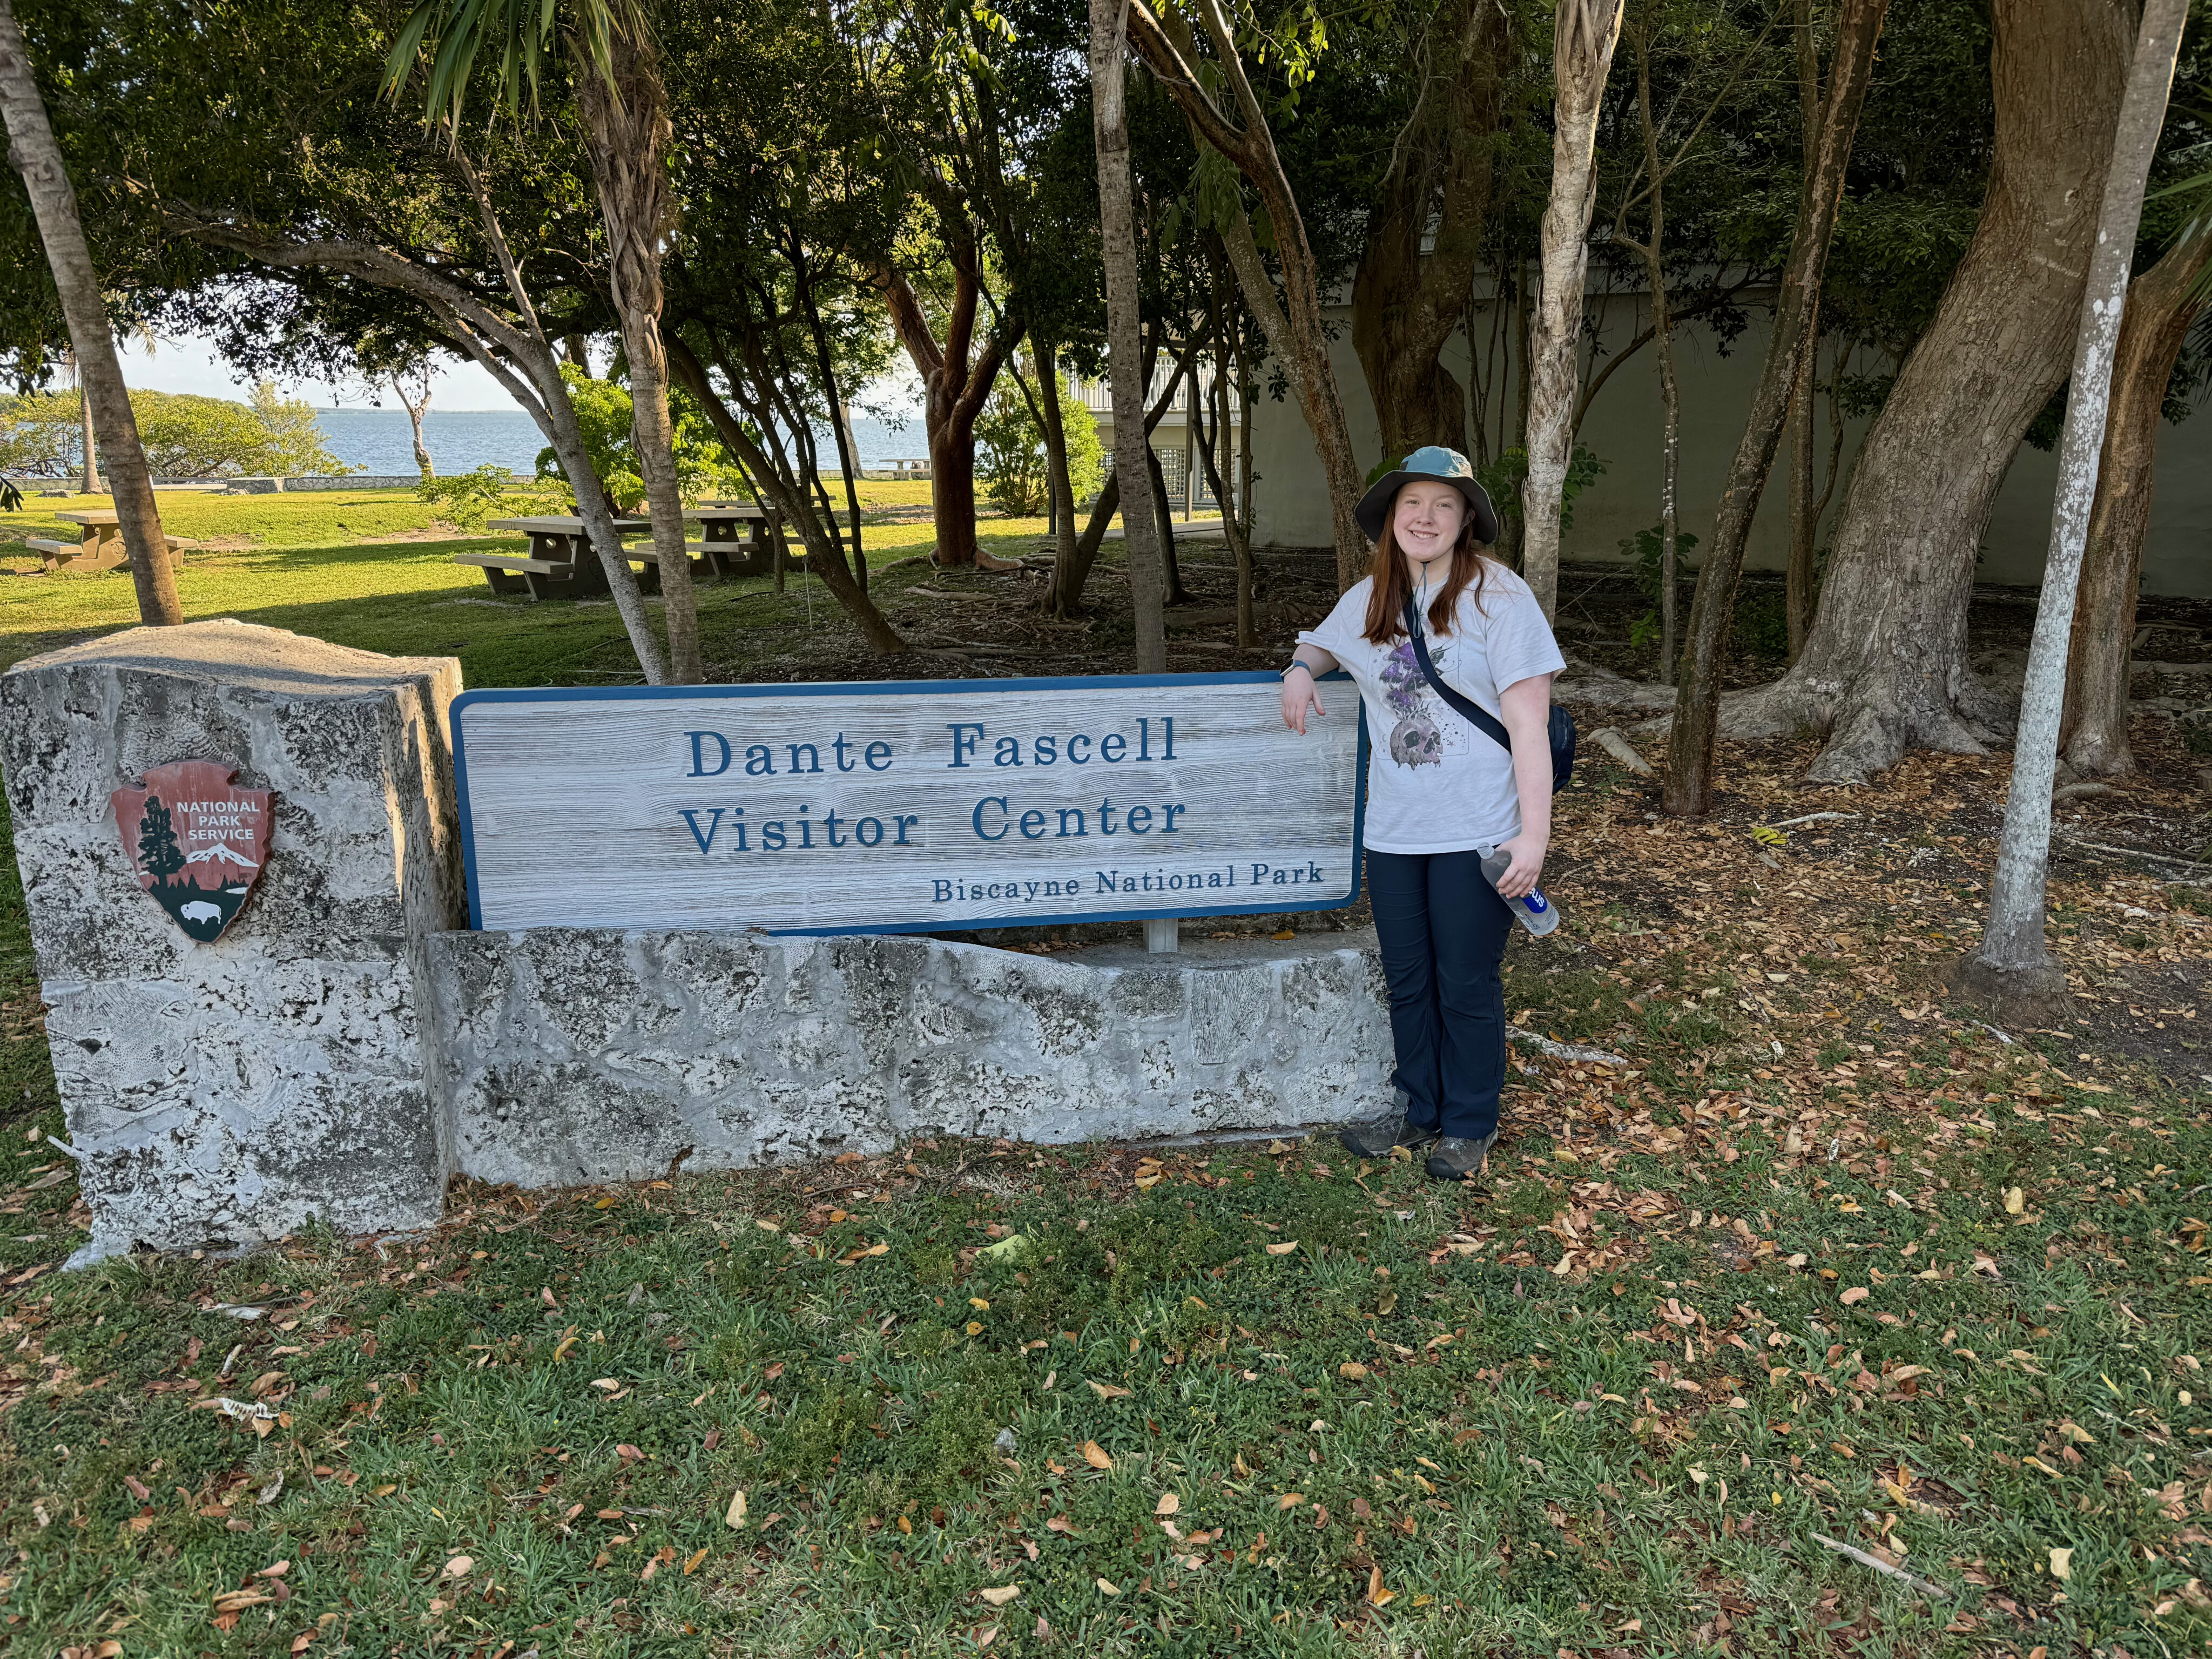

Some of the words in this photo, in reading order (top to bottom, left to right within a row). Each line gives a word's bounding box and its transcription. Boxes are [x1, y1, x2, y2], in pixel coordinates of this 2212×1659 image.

[684, 731, 893, 777] Dante
[947, 717, 1177, 767] Fascell
[177, 801, 260, 813] NATIONAL
[198, 815, 241, 826] PARK
[677, 804, 918, 854] Visitor
[972, 796, 1185, 840] Center
[188, 828, 254, 840] SERVICE
[932, 878, 1079, 902] Biscayne
[1095, 865, 1235, 893] National
[1250, 861, 1324, 886] Park
